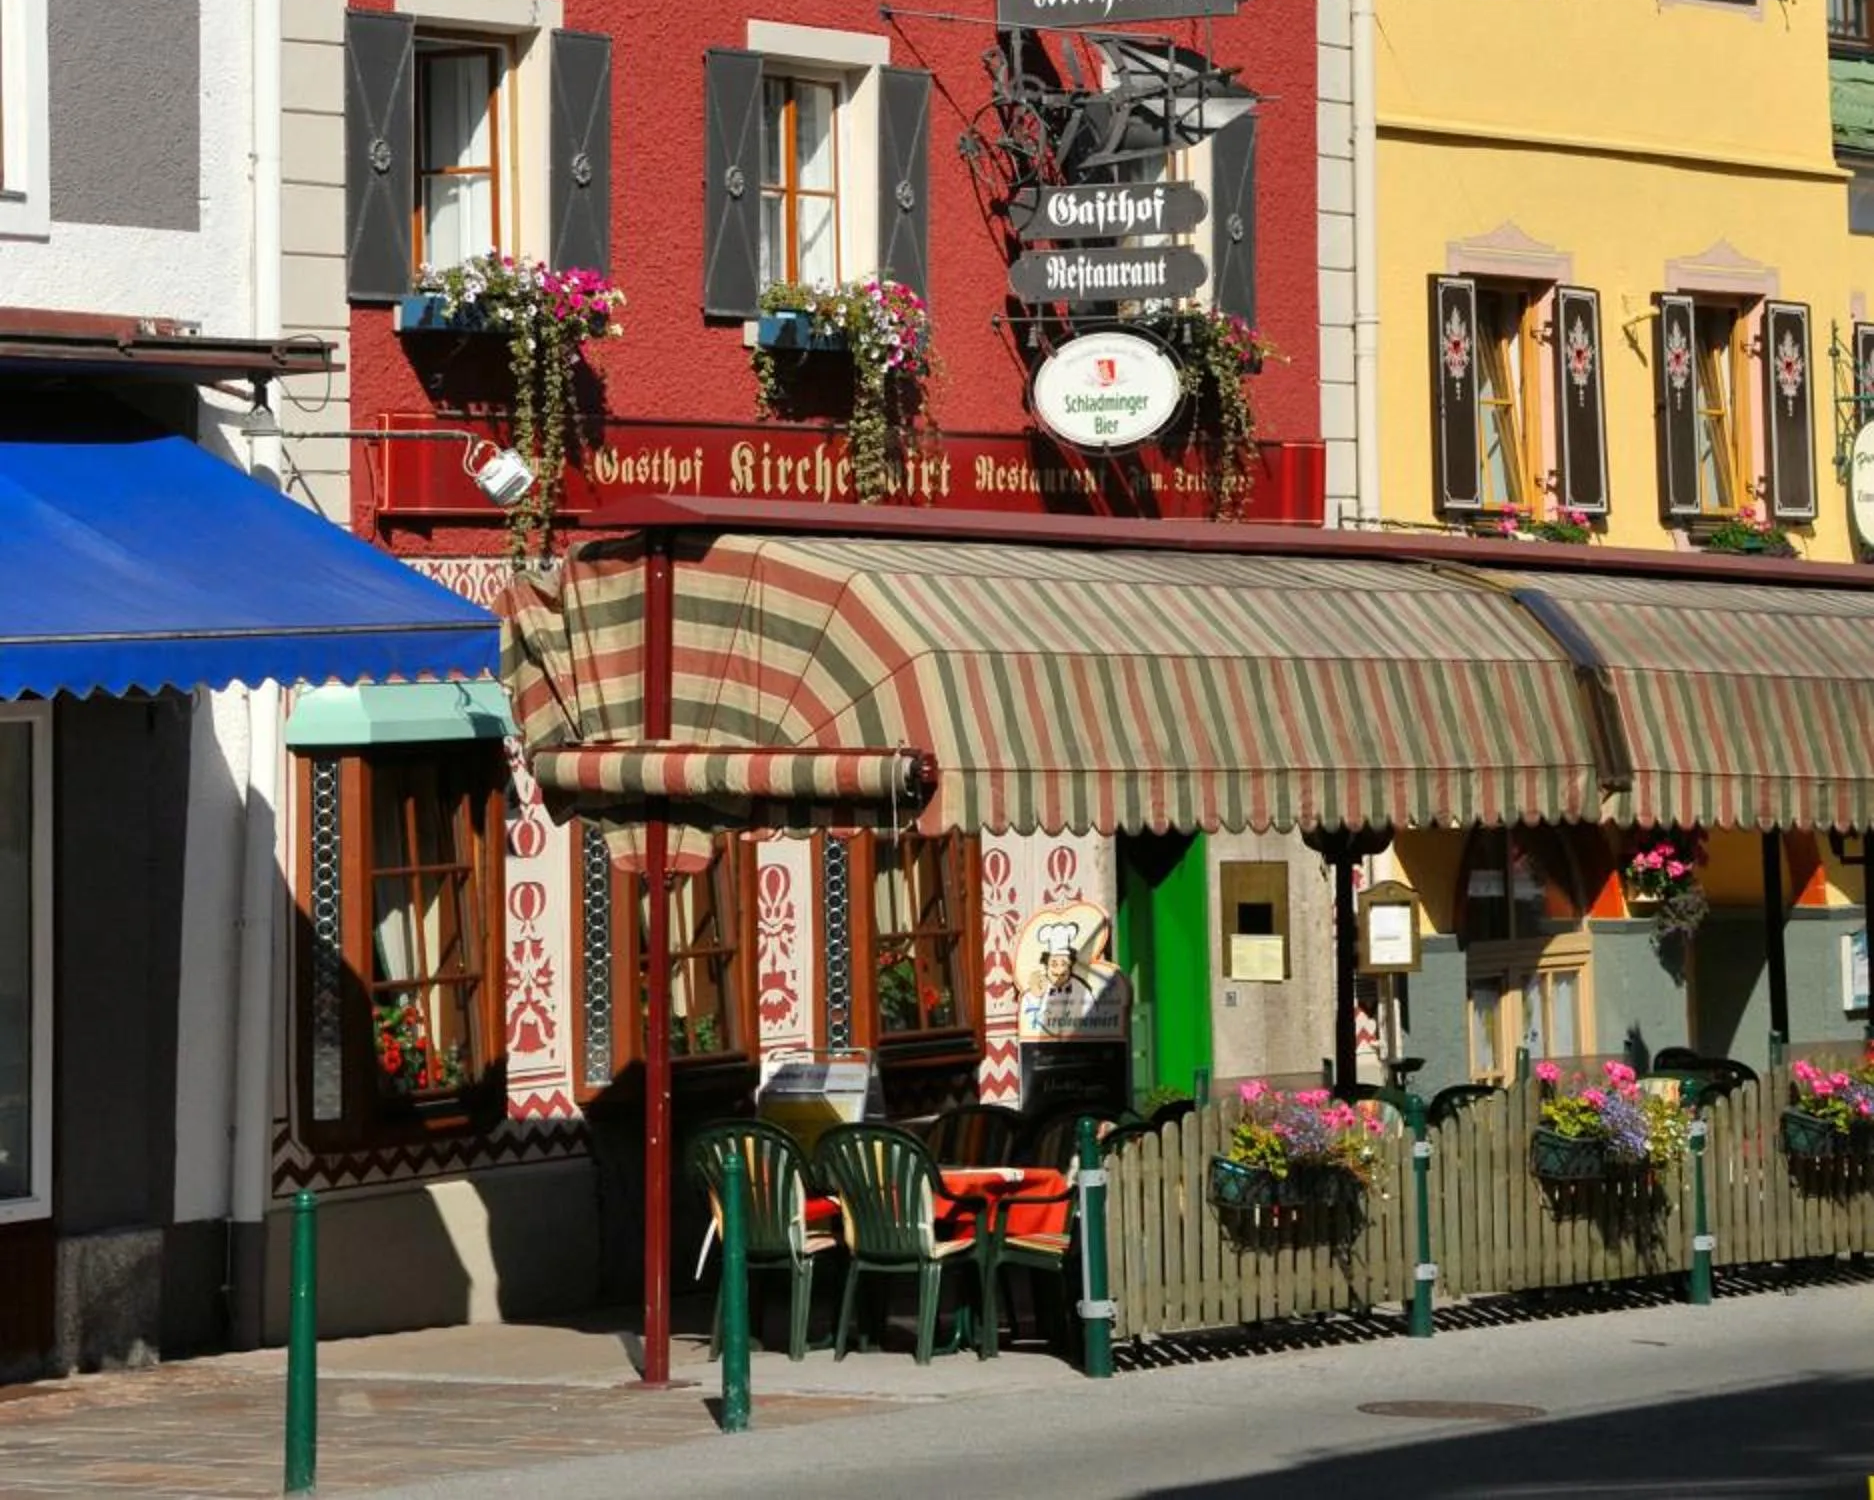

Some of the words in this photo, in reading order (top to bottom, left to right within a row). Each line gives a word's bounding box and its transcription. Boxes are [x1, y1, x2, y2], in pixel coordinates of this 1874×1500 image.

[1047, 187, 1165, 235] Gasthof
[1046, 255, 1167, 299] Restaurant
[1065, 393, 1149, 416] Schladminger
[1095, 416, 1119, 435] Bier
[594, 445, 704, 494] Gasthof
[730, 441, 951, 503] Kirchewirt
